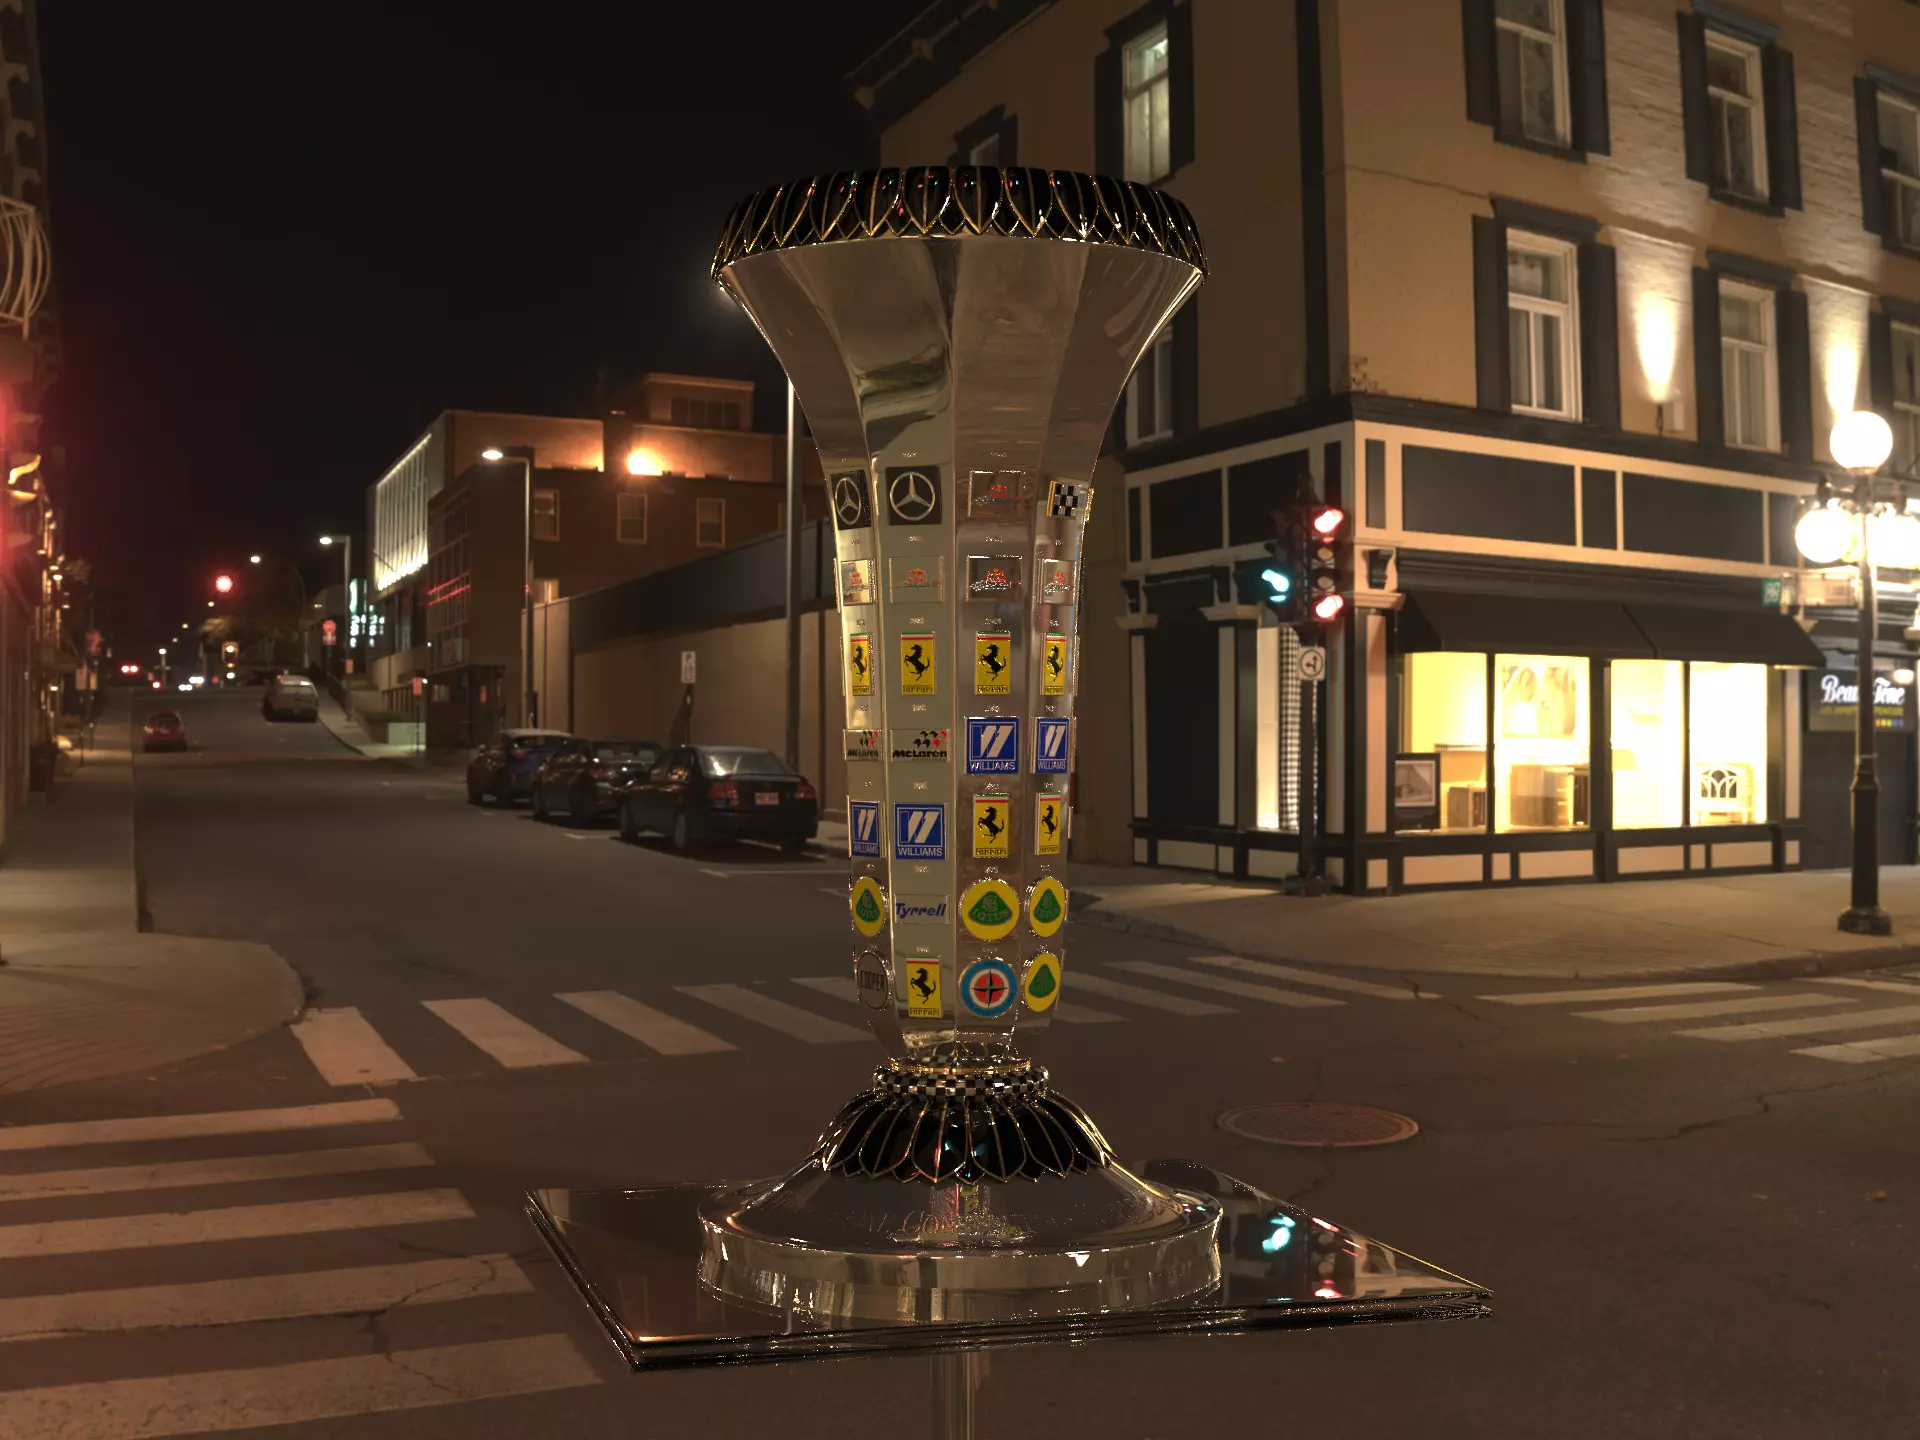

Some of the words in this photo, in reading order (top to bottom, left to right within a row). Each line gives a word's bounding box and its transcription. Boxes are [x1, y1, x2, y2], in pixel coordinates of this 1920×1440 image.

[847, 749, 879, 757] McLaren
[892, 749, 947, 758] McLaren
[970, 761, 1015, 771] WILLIAMS
[1038, 761, 1066, 770] WILLIAMS
[854, 844, 878, 854] WILLIAMS
[898, 847, 942, 856] WILLIAMS
[896, 902, 946, 919] Tyrrell
[972, 908, 1009, 921] LOTUS
[860, 970, 885, 991] COOPER
[909, 1007, 940, 1015] Ferrari
